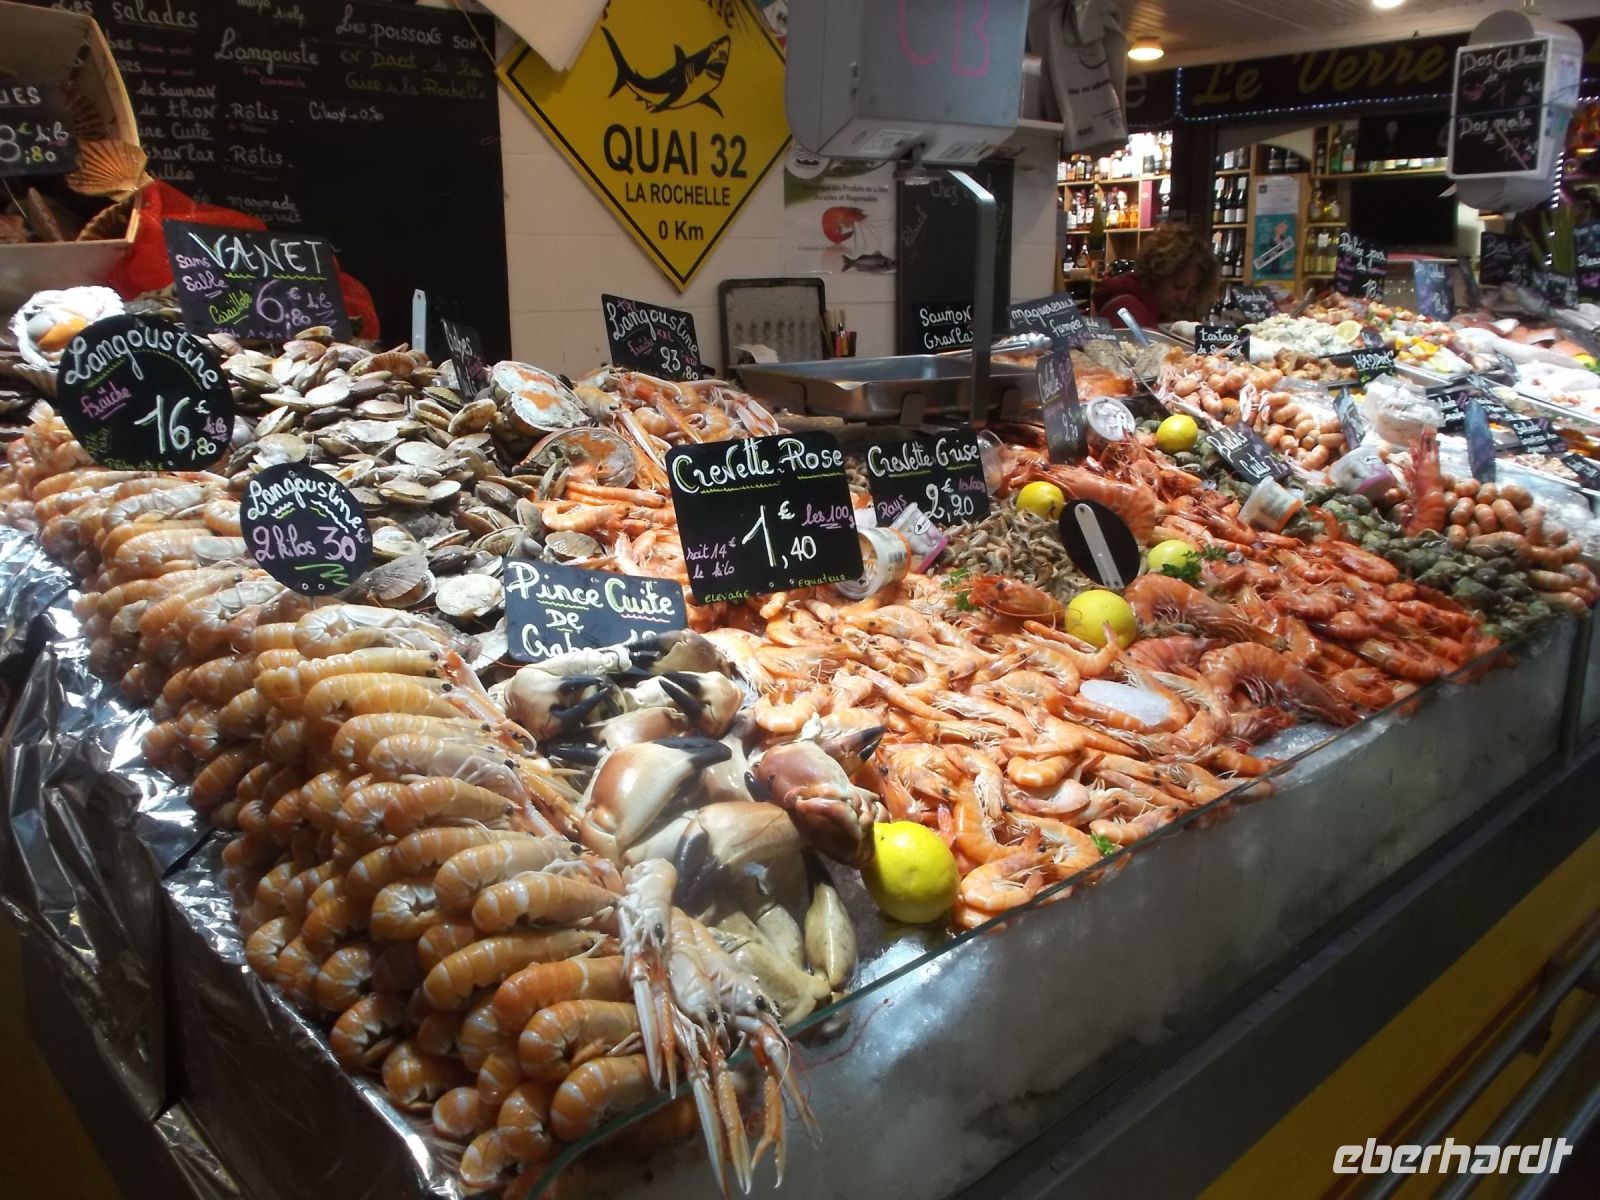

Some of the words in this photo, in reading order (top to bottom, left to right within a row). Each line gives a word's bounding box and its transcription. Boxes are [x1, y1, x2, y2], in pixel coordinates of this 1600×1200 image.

[335, 4, 367, 35] Les
[213, 27, 320, 76] Langouste
[1193, 63, 1262, 107] Le
[1292, 44, 1448, 95] Verre
[602, 123, 698, 176] QUAI
[709, 132, 748, 179] 32
[625, 182, 647, 203] LA
[650, 183, 731, 207] ROCHELLE
[658, 220, 669, 241] 0
[675, 219, 704, 241] Km
[188, 231, 323, 278] VANET
[255, 279, 285, 324] 6
[919, 305, 973, 328] Saumon
[660, 346, 682, 373] 23
[133, 394, 191, 455] 16
[671, 437, 775, 494] Crevette
[777, 437, 844, 472] Rose
[867, 440, 934, 478] Crevette
[935, 437, 981, 467] Grise
[252, 525, 276, 562] 2
[317, 526, 357, 563] 30
[740, 505, 777, 568] 1
[506, 561, 604, 608] Pince
[604, 577, 676, 616] Cuite
